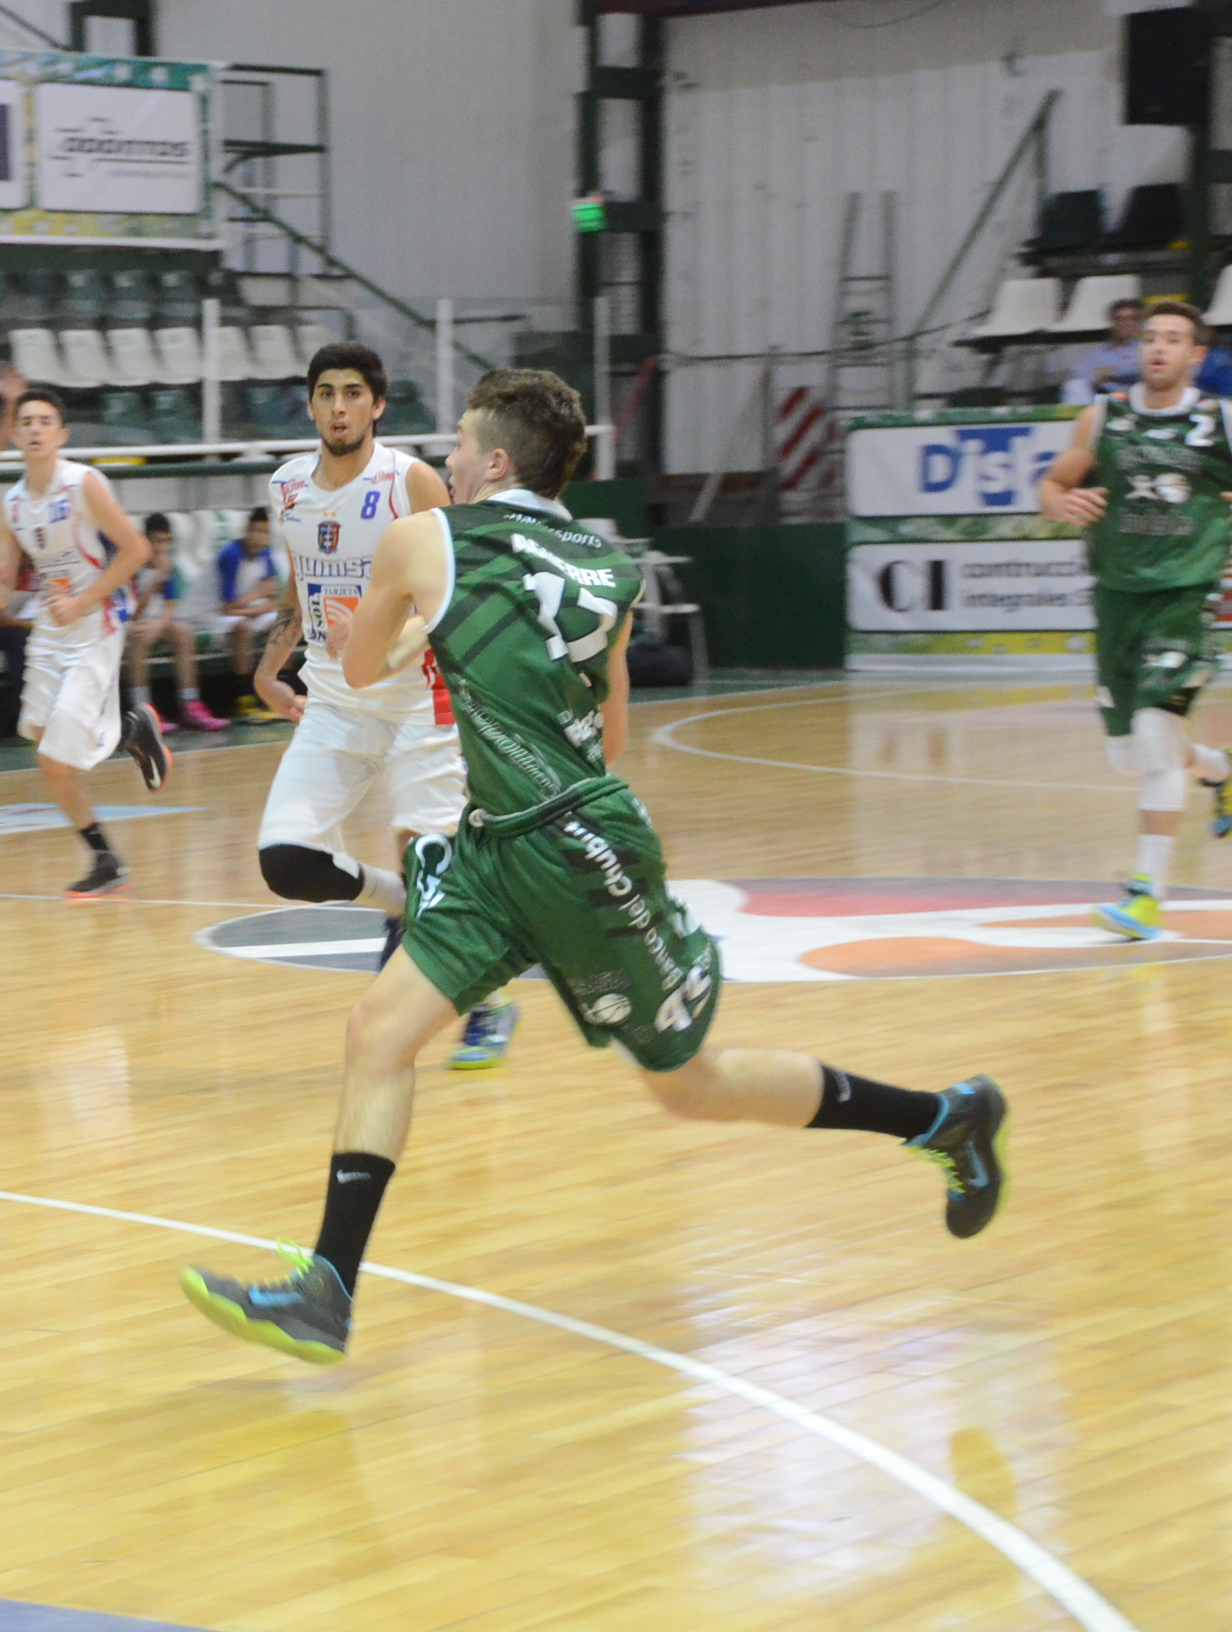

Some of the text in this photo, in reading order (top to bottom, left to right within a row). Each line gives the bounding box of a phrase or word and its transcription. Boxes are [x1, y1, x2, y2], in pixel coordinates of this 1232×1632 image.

[1184, 413, 1216, 447] 2
[360, 490, 381, 520] 8
[876, 559, 947, 613] CI
[522, 571, 618, 664] 12
[619, 893, 652, 930] del
[644, 926, 684, 991] Banco
